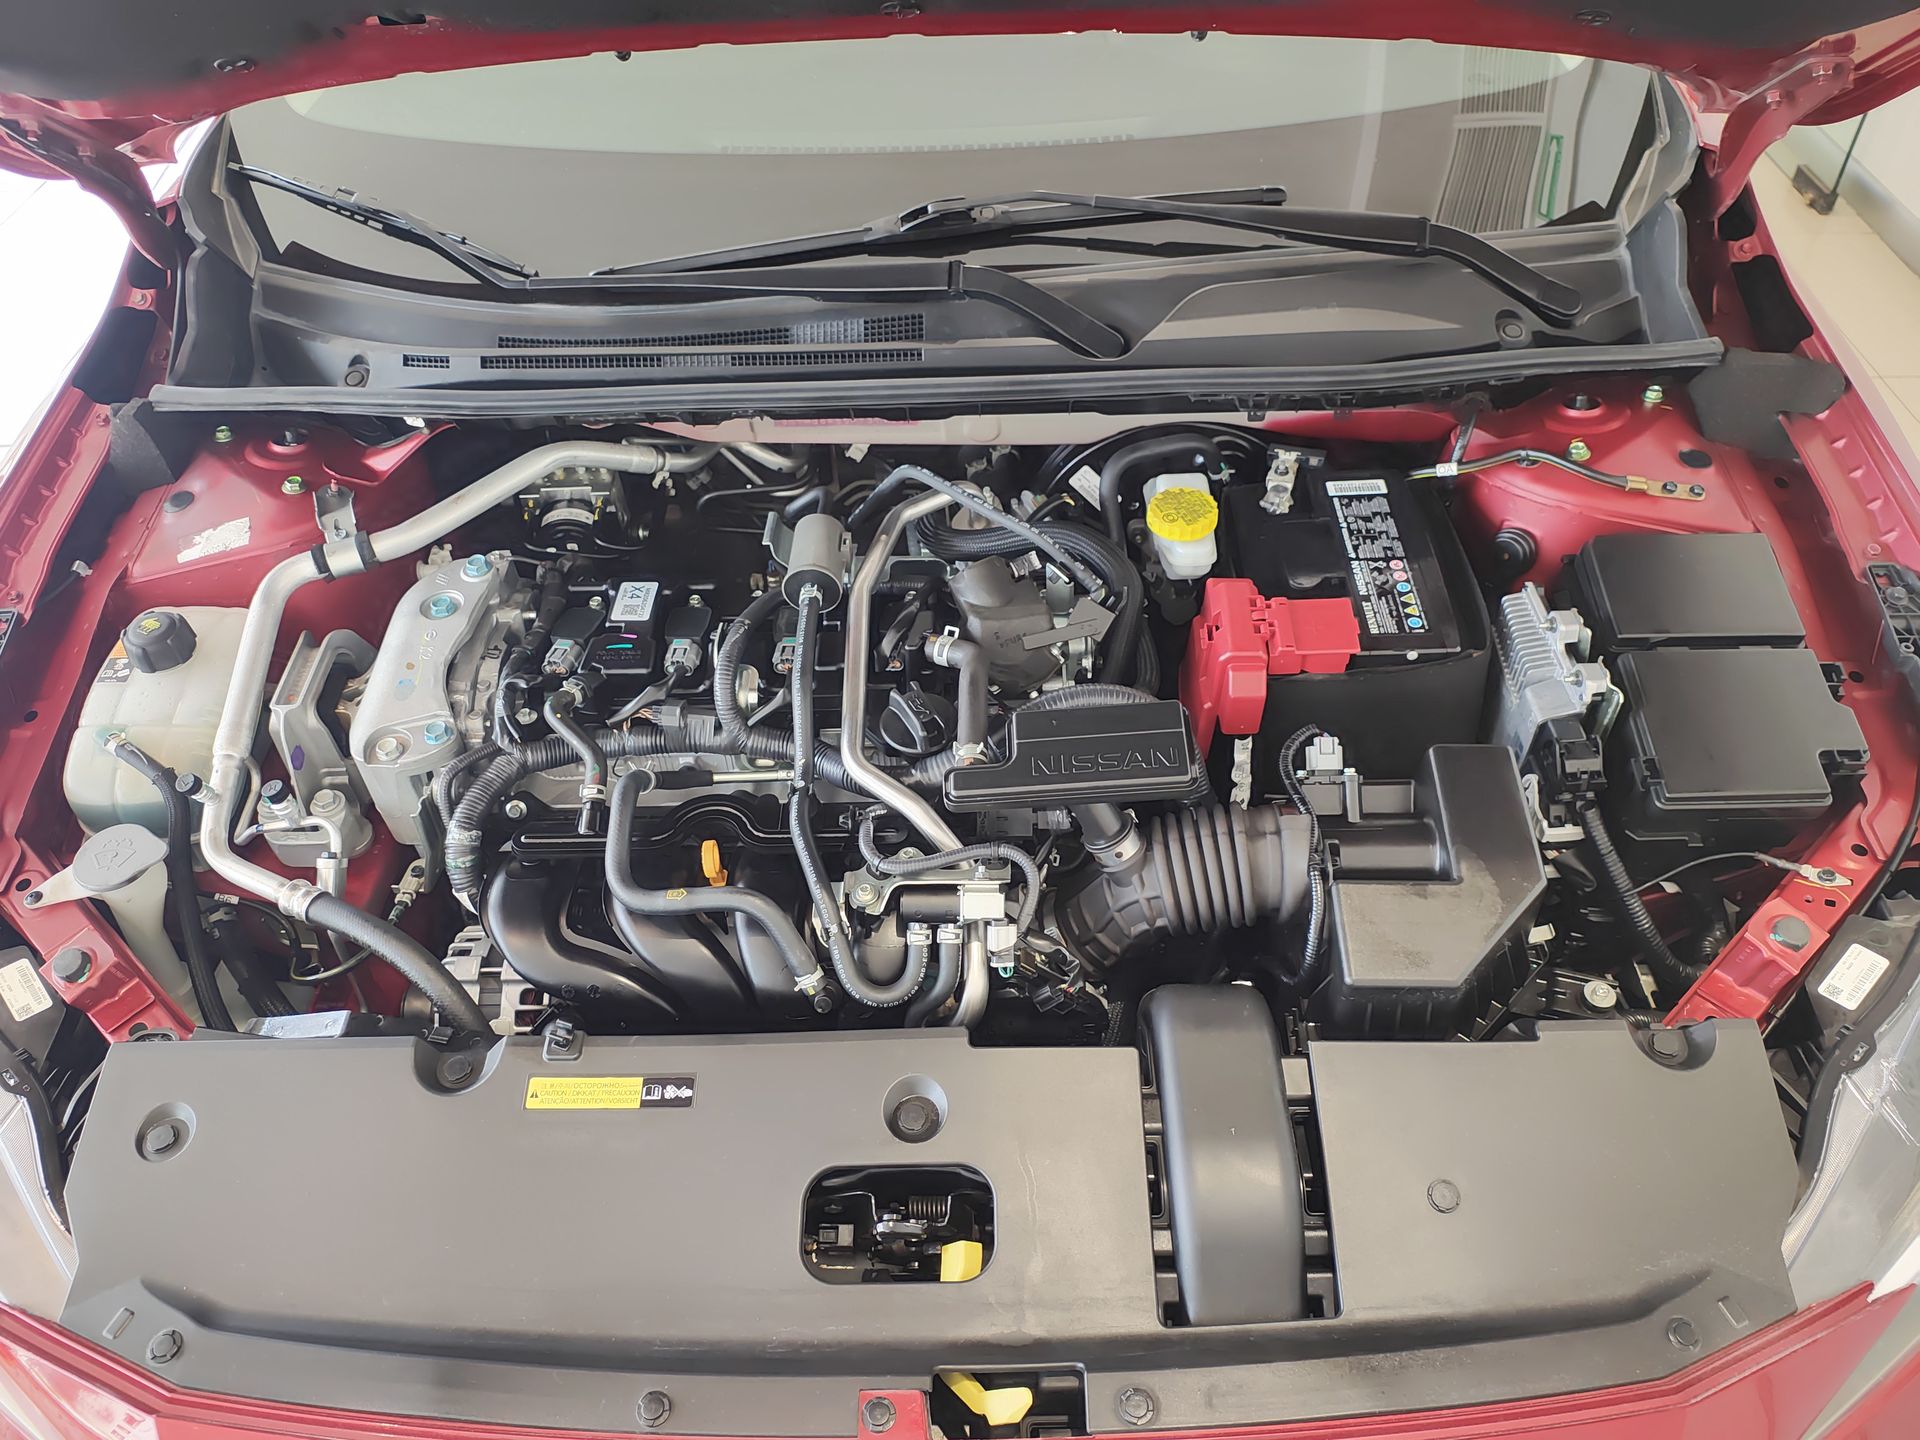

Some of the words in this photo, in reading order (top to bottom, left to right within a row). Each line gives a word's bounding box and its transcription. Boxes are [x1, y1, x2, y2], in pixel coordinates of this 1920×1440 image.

[627, 585, 646, 600] X4
[1350, 560, 1369, 596] NISSAN
[1031, 746, 1180, 777] NISSAN
